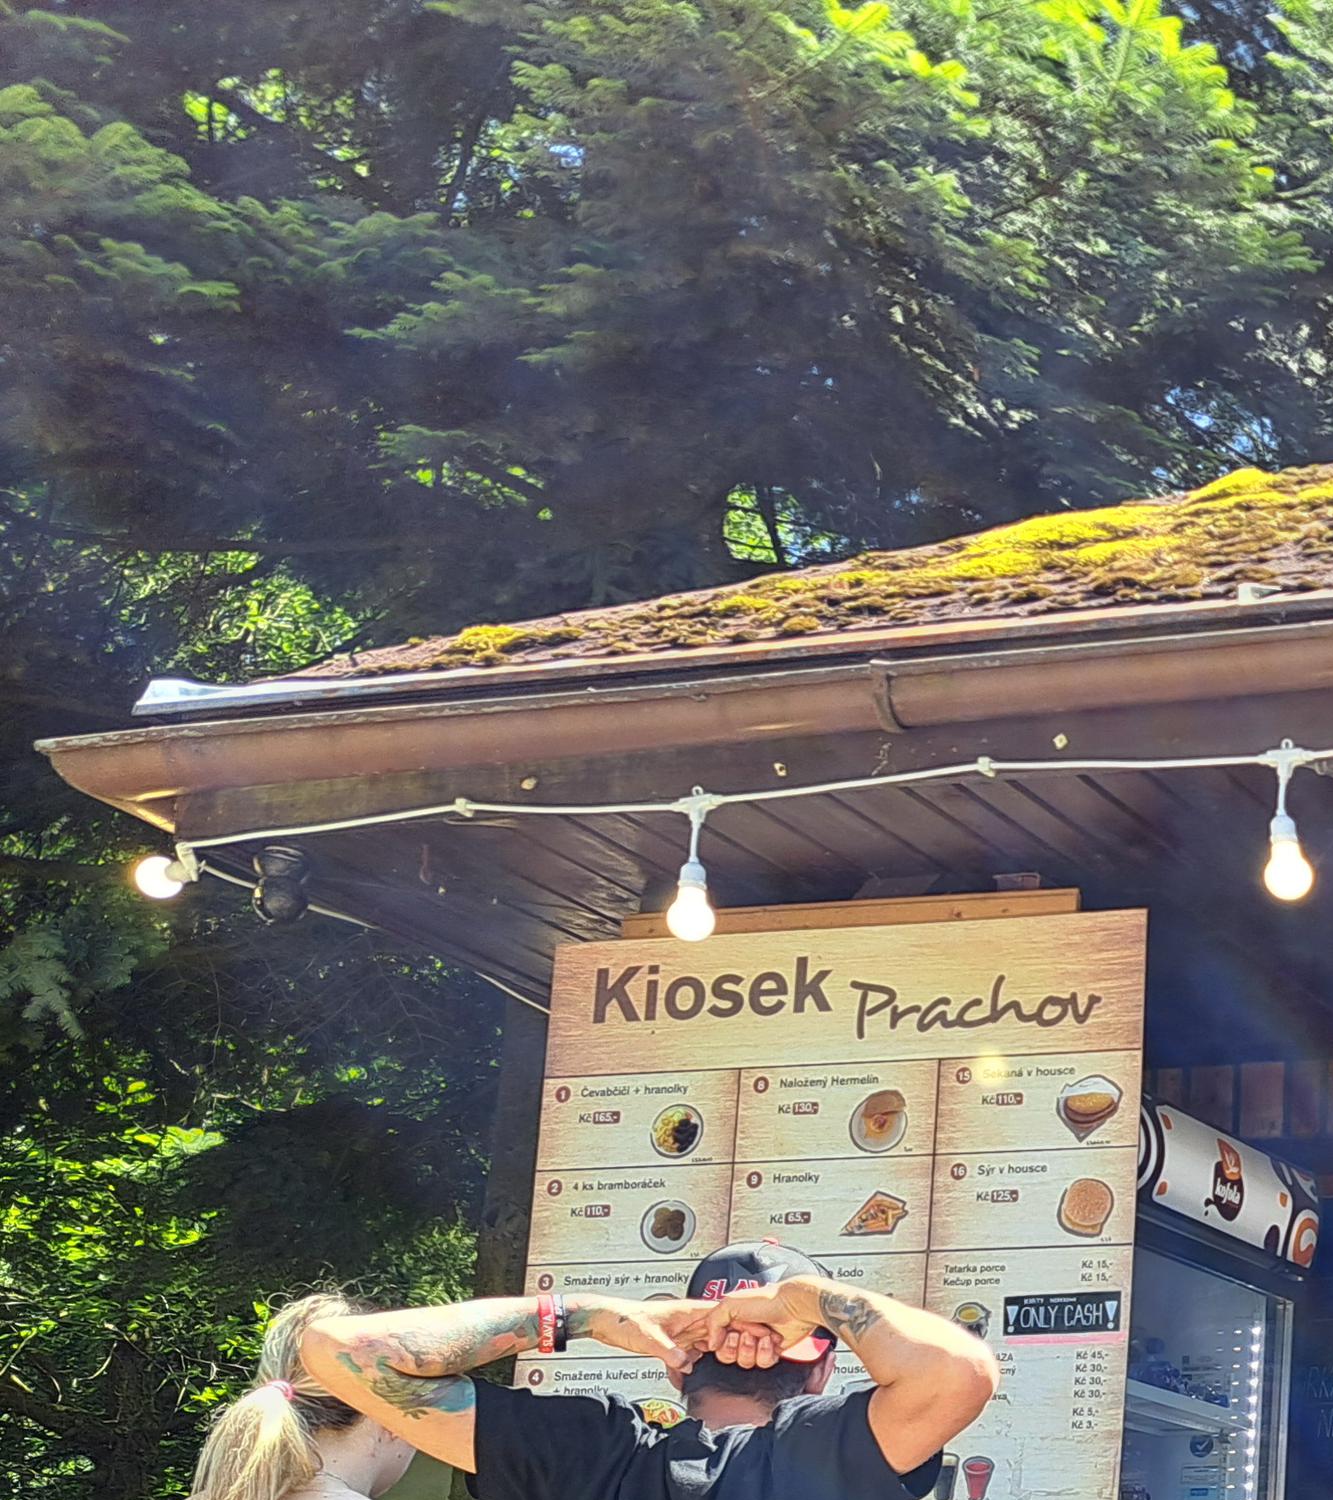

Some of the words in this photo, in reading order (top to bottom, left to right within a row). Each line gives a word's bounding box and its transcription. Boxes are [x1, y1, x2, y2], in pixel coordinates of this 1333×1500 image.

[592, 956, 832, 1025] Kiosek
[849, 975, 1103, 1040] Prachov
[958, 1071, 970, 1081] 15
[1036, 1066, 1076, 1076] housce
[779, 1076, 828, 1089] Naložený
[644, 1084, 689, 1097] hranolky
[982, 1094, 995, 1105] Kč
[778, 1104, 791, 1114] Kč
[578, 1113, 592, 1123] Kč
[953, 1166, 966, 1177] 16
[977, 1164, 996, 1177] Sýr
[999, 1166, 1006, 1174] v
[1008, 1163, 1047, 1174] housce
[573, 1182, 579, 1191] 4
[582, 1180, 594, 1191] ks
[597, 1178, 666, 1190] bramboráček
[773, 1173, 820, 1185] Hranolky
[976, 1191, 990, 1201] Kč
[1214, 1177, 1241, 1205] kofola
[570, 1207, 584, 1217] Kč
[770, 1214, 783, 1224] Kč
[944, 1264, 978, 1273] Tatarka
[980, 1264, 1006, 1273] porce
[1081, 1260, 1094, 1269] Kč
[564, 1273, 612, 1287] Smažený
[614, 1273, 630, 1286] sýr
[644, 1272, 690, 1285] hranolky
[943, 1276, 972, 1287] Kečup
[975, 1276, 1000, 1286] porce
[1081, 1273, 1092, 1282] Kč
[1019, 1306, 1058, 1329] ONLY
[1064, 1303, 1103, 1327] CASH
[542, 1313, 554, 1348] SLAVIA
[554, 1371, 602, 1381] Smažené
[605, 1368, 638, 1381] kuřecí
